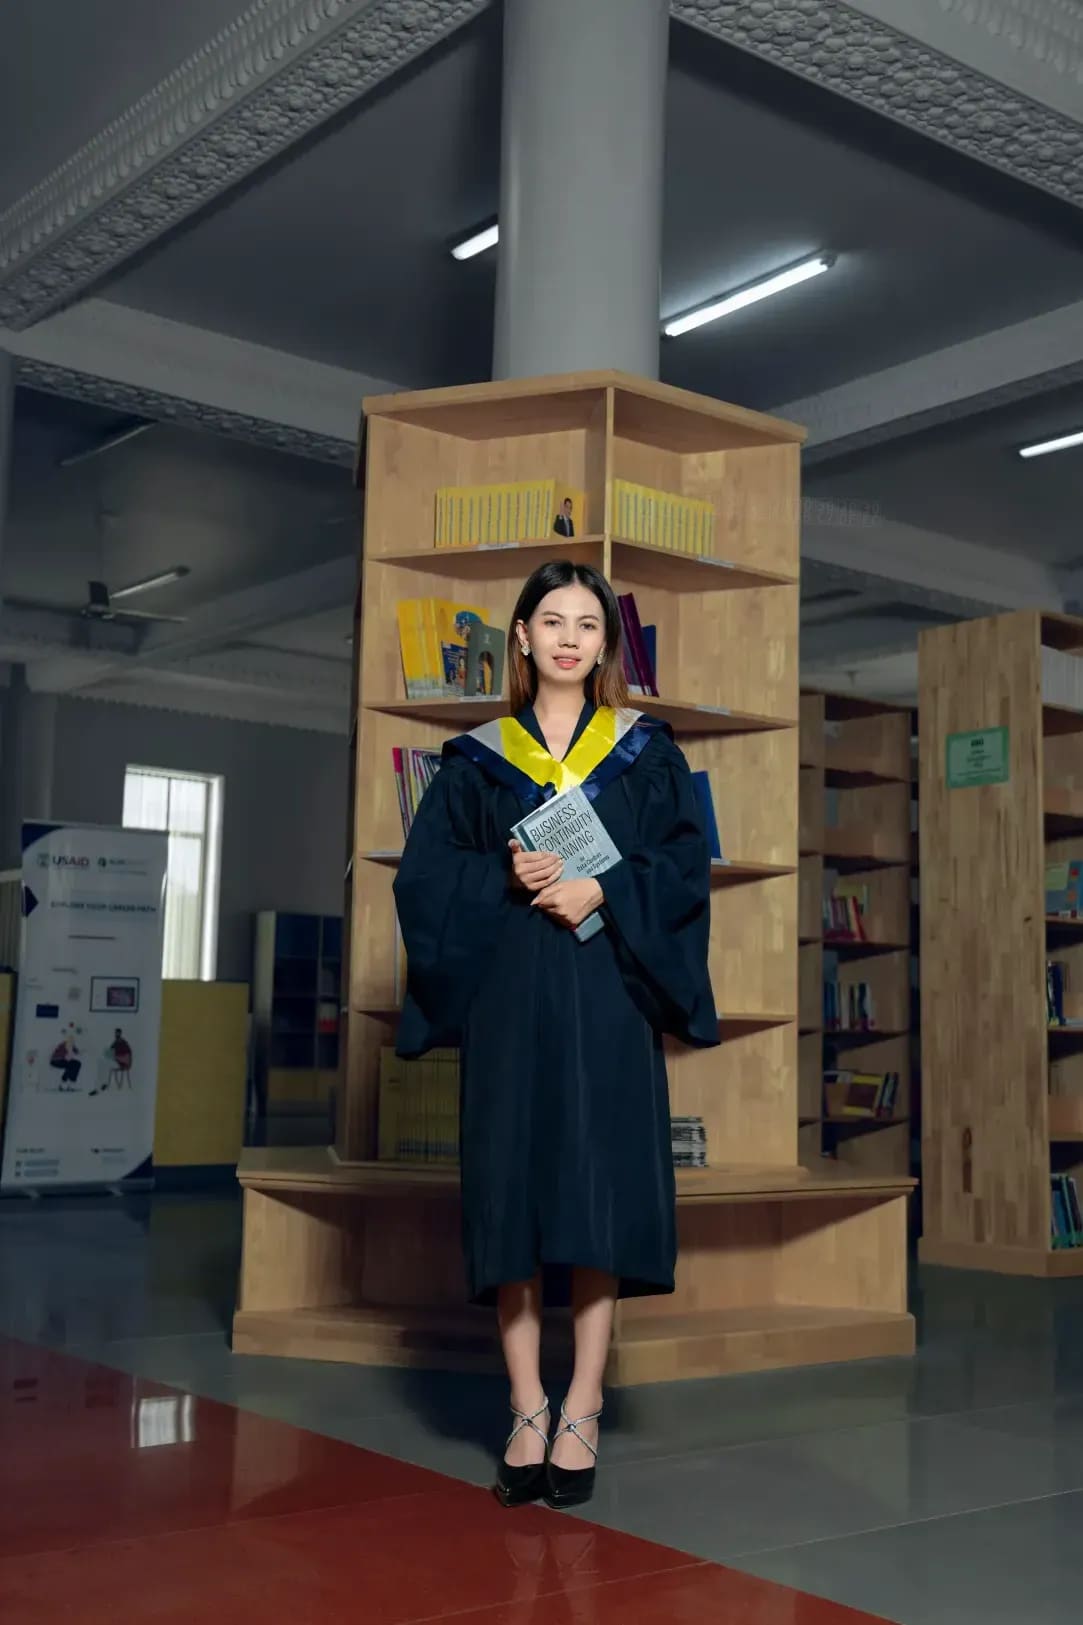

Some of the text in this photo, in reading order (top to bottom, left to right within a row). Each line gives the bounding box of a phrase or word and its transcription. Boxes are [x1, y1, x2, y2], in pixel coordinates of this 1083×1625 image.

[529, 803, 577, 843] BUSINESS
[538, 809, 593, 852] CONTINUITY
[52, 855, 90, 866] USAID
[557, 830, 594, 861] ANNING
